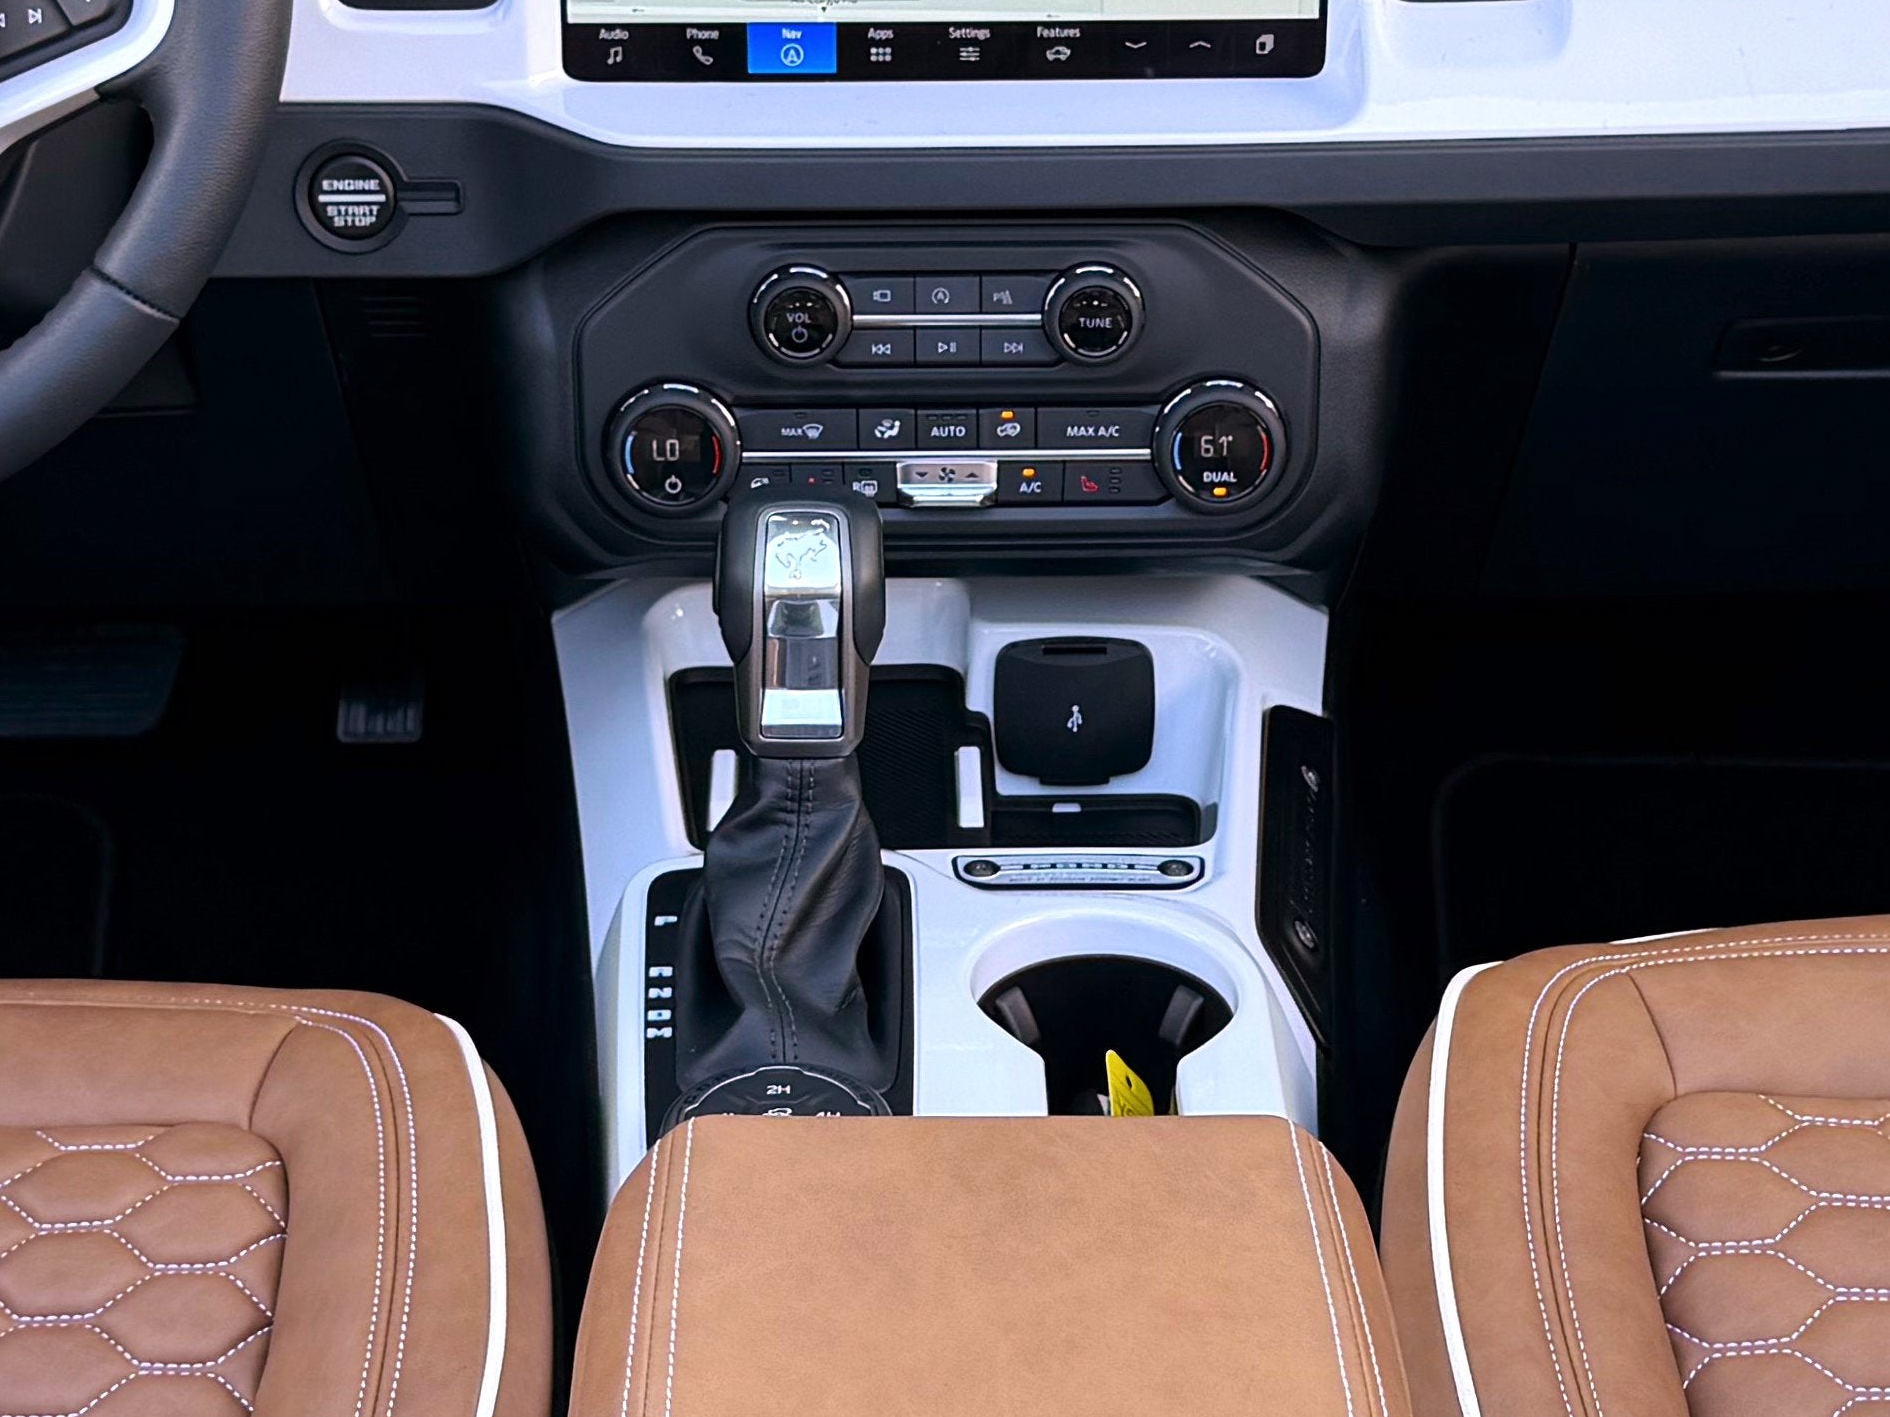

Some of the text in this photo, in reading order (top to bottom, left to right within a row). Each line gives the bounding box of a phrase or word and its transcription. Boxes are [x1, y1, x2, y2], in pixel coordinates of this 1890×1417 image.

[598, 28, 629, 40] Audio
[685, 28, 720, 40] Phone
[781, 28, 803, 40] Nav
[867, 27, 894, 40] Apps
[948, 26, 991, 41] Settings
[1036, 26, 1081, 39] Features
[322, 179, 381, 192] ENGINE
[326, 205, 380, 217] START
[333, 215, 377, 228] STOP
[785, 312, 812, 325] VOL
[1078, 317, 1113, 330] TUNE
[781, 427, 803, 438] MAX
[930, 426, 967, 438] AUTO
[1066, 425, 1120, 437] MAX A/C
[652, 438, 680, 462] LO
[1202, 471, 1237, 483] DUAL
[1018, 482, 1042, 494] A/C
[648, 987, 673, 998] N
[646, 1027, 673, 1038] M
[766, 1084, 791, 1095] 2H
